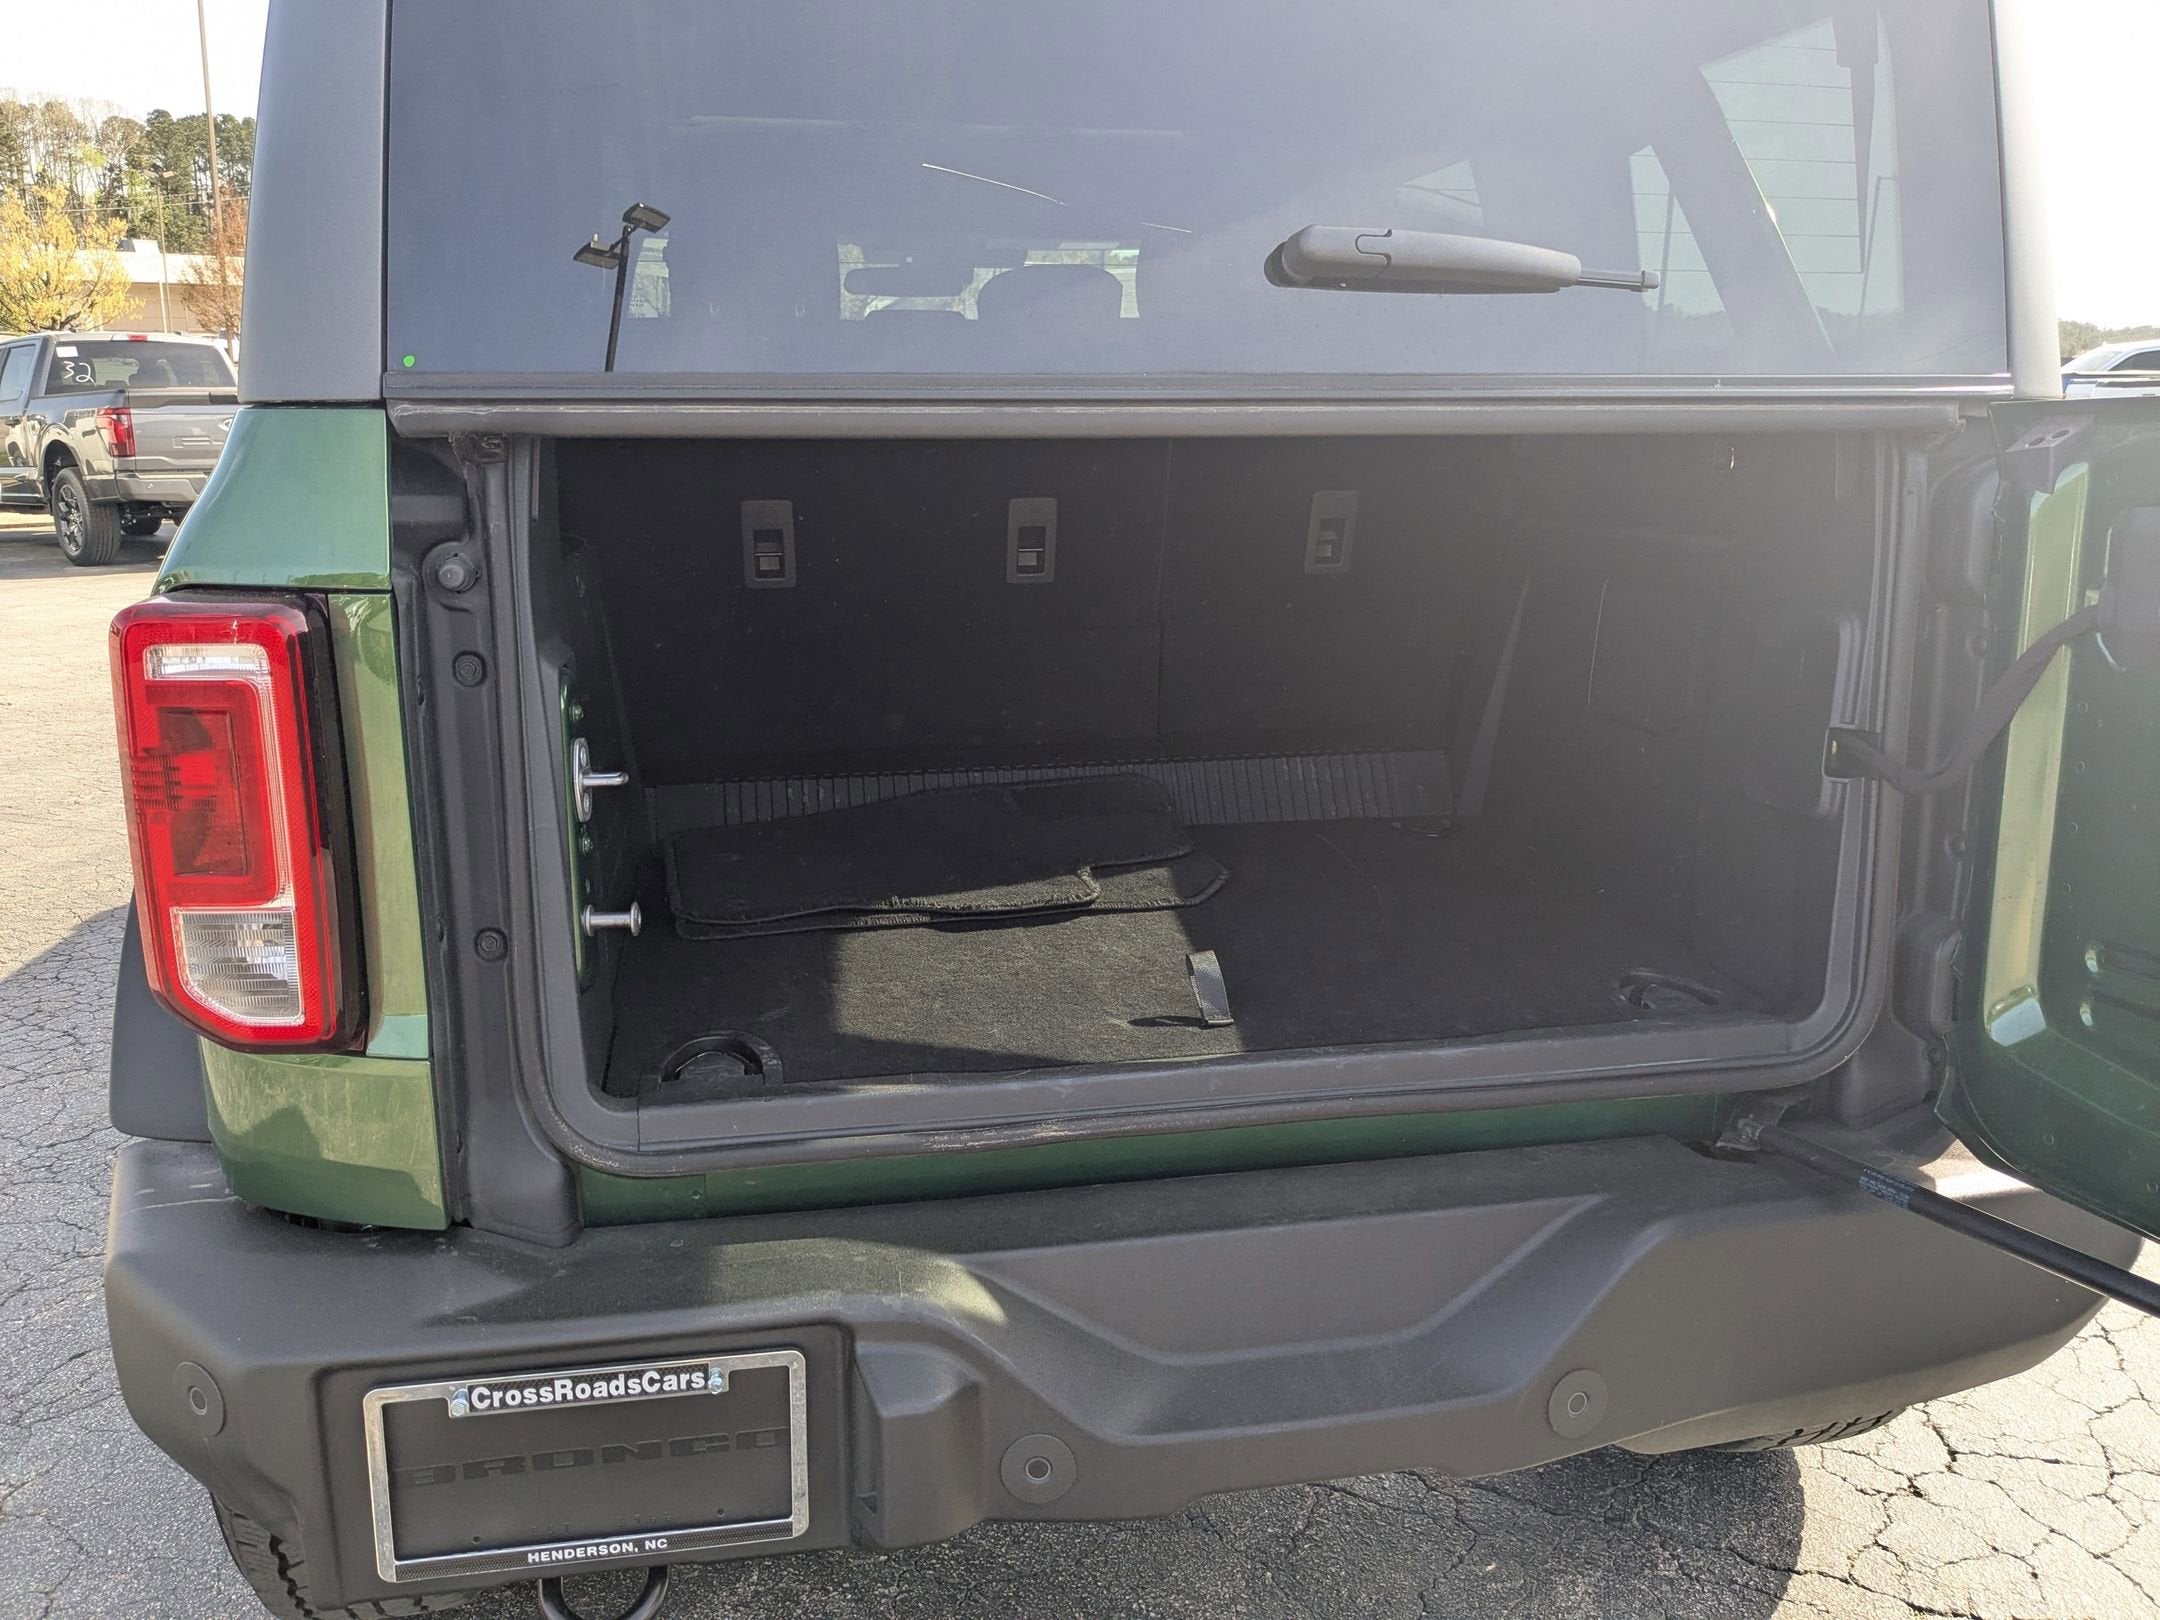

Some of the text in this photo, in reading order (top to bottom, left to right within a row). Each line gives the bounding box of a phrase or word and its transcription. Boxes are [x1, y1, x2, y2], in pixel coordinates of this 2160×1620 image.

[63, 361, 96, 386] 32
[471, 1369, 706, 1409] CrossRoadsCars
[390, 1427, 789, 1486] BRONCO
[528, 1538, 668, 1563] HENDERSON, NC
